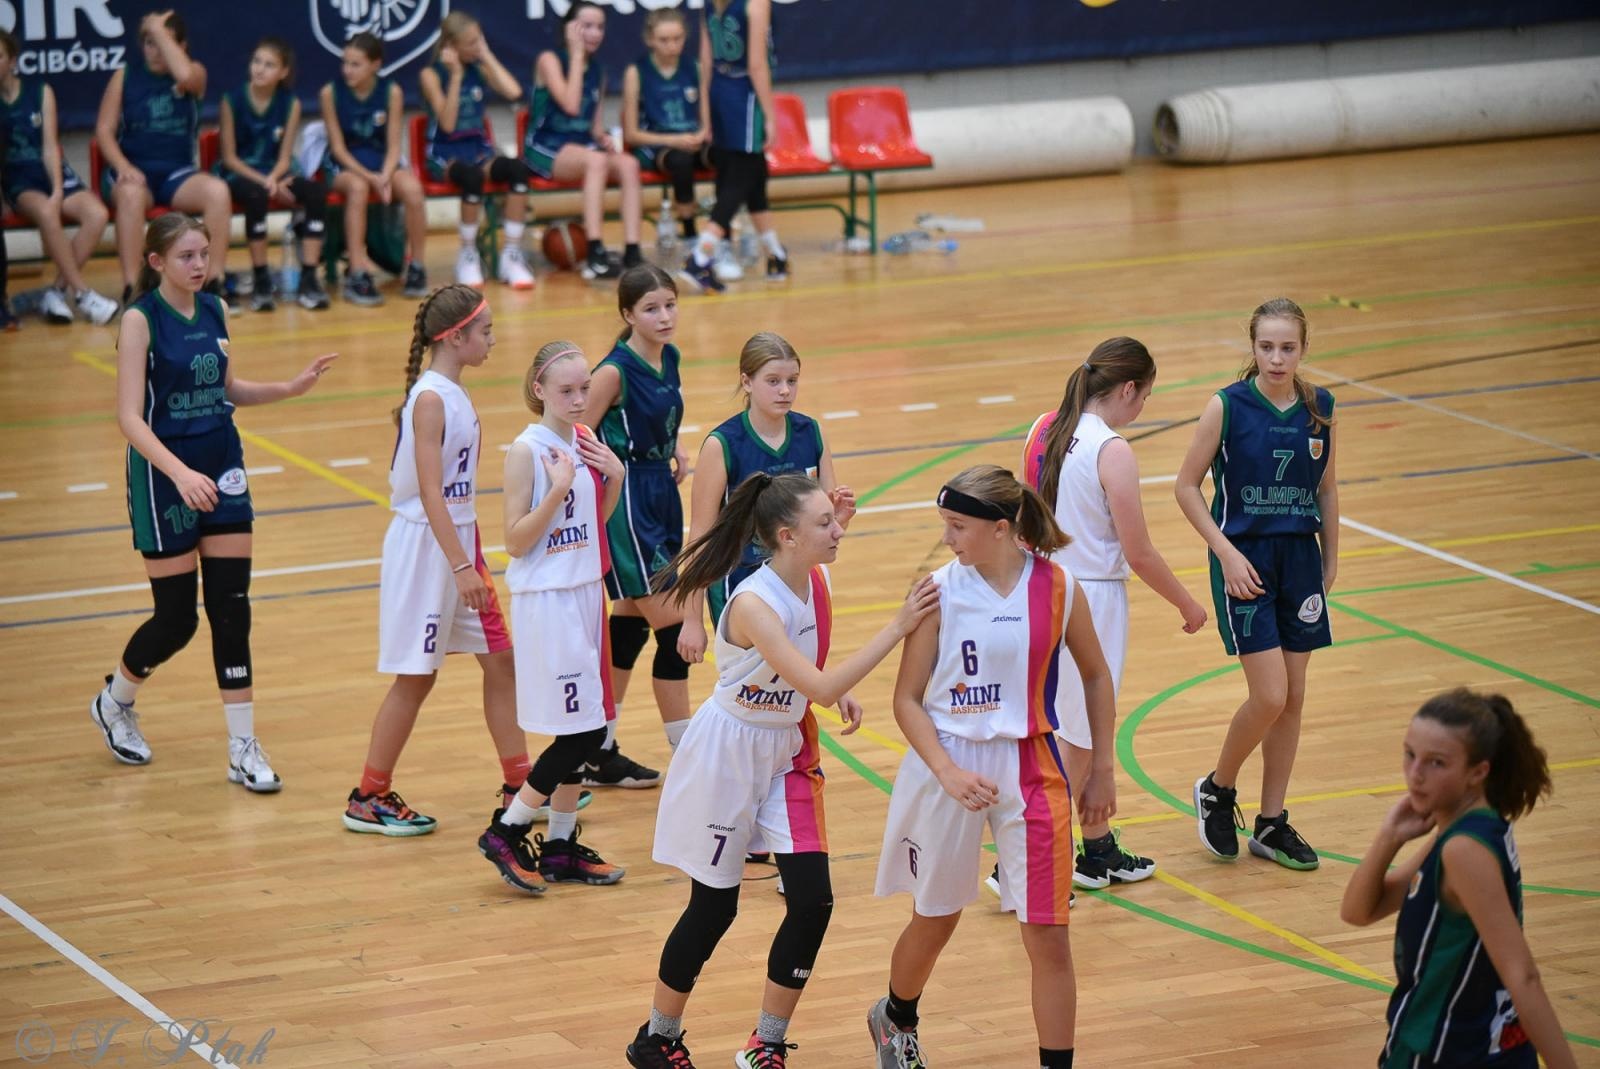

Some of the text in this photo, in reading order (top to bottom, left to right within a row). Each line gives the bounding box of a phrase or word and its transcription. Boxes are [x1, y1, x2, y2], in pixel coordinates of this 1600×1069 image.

[13, 41, 126, 75] CIBÓRZ
[190, 352, 220, 386] 18
[1273, 449, 1295, 481] 7
[563, 488, 576, 521] 2
[1240, 485, 1315, 506] OLIMPIA
[546, 523, 589, 549] MINI
[1234, 605, 1259, 638] 7
[423, 623, 438, 654] 2
[961, 640, 979, 676] 6
[564, 682, 580, 713] 2
[737, 684, 796, 706] MINI
[949, 682, 1001, 706] MINI
[710, 833, 728, 867] 7
